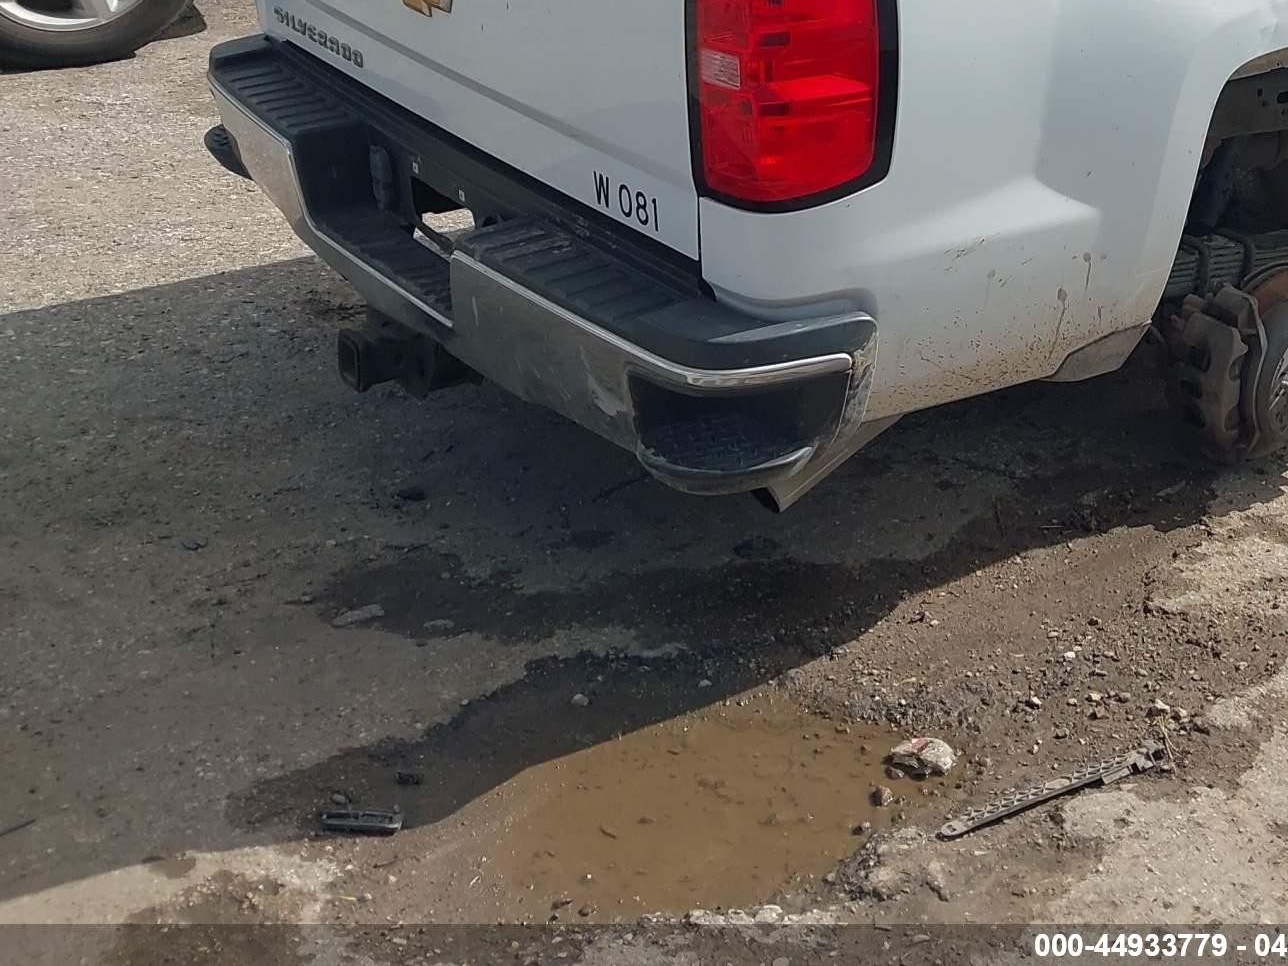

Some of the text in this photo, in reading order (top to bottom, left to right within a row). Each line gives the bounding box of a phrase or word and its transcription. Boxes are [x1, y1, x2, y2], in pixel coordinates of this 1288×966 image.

[273, 7, 364, 68] SILVERADO
[593, 170, 659, 232] W 081
